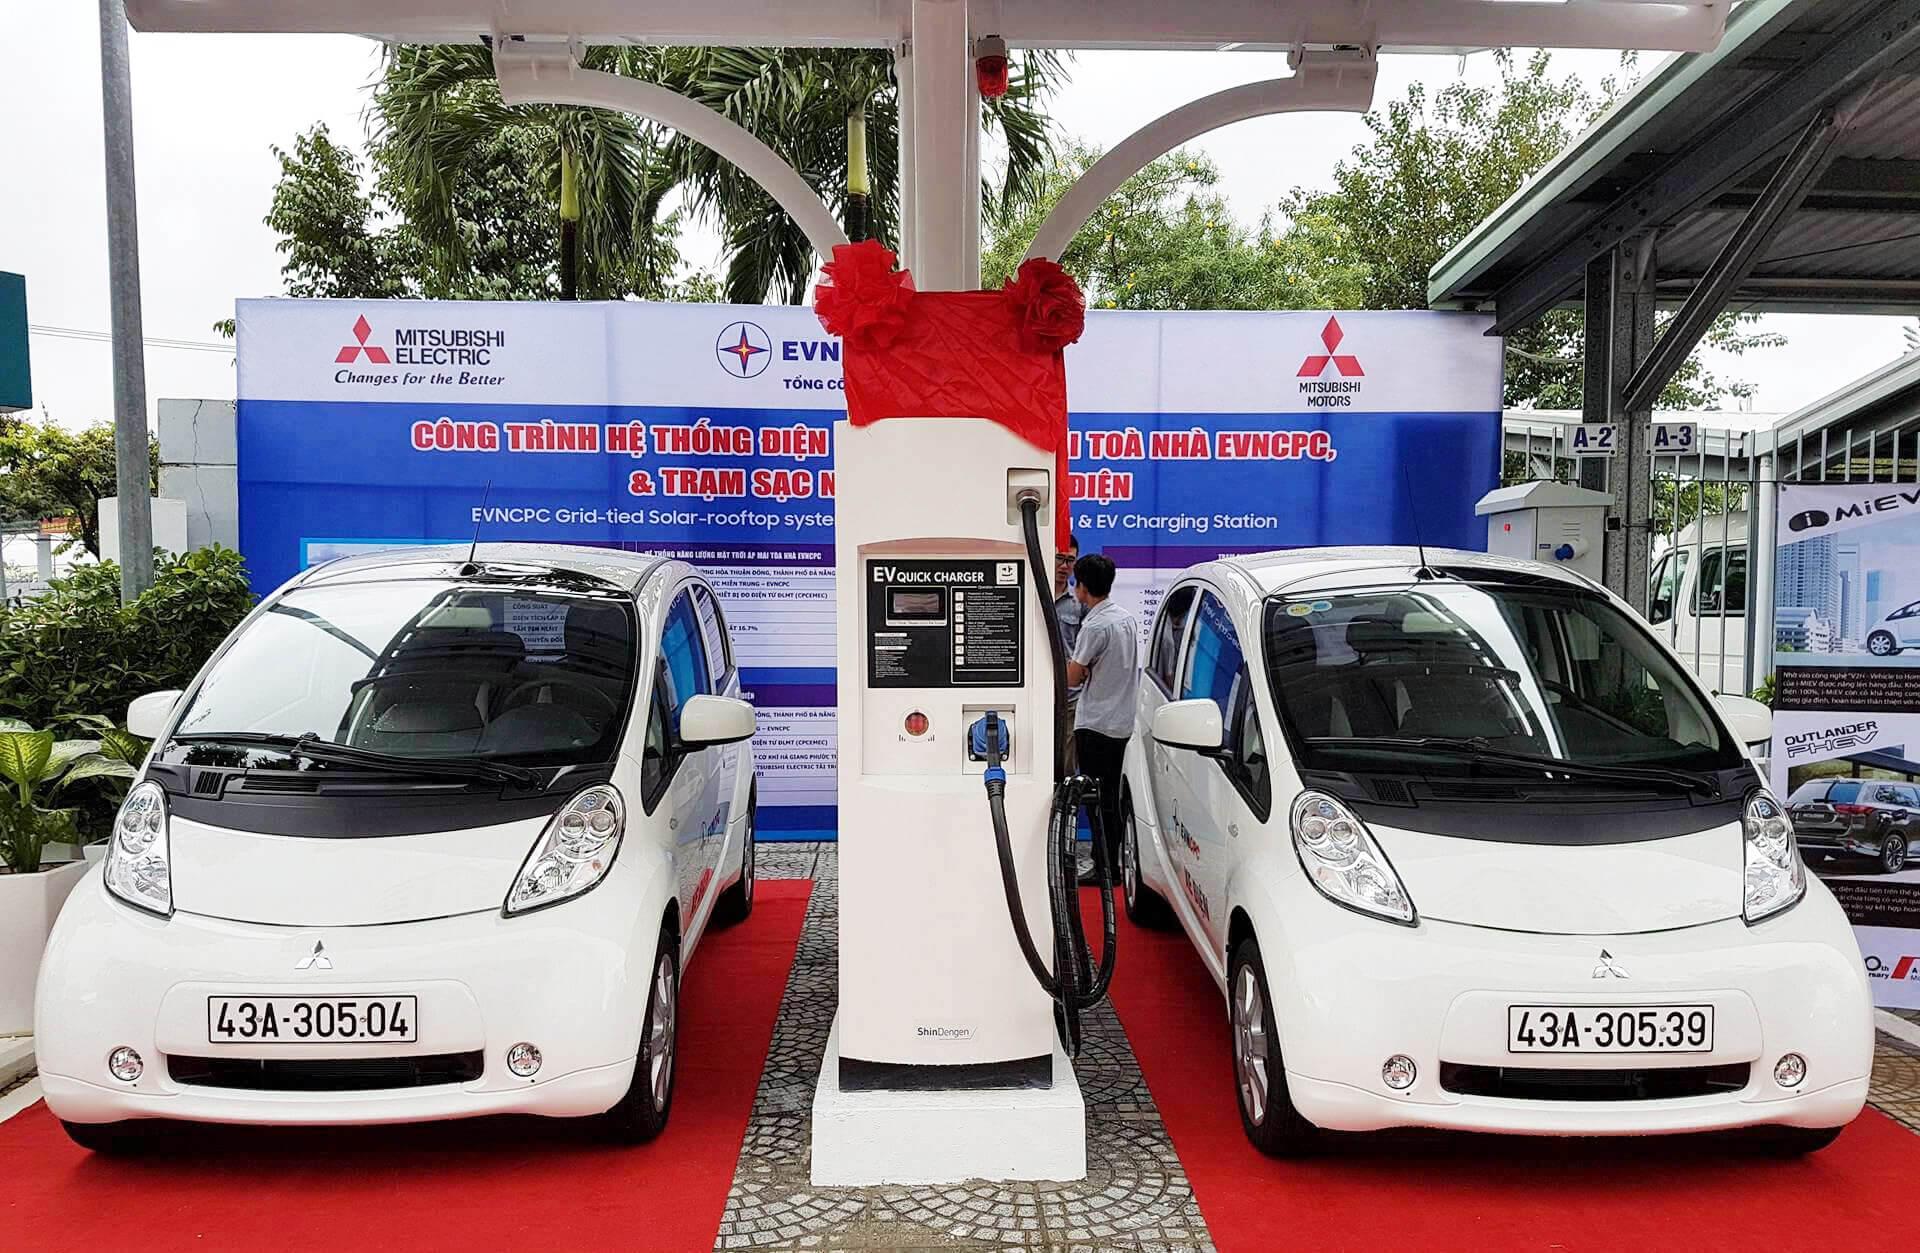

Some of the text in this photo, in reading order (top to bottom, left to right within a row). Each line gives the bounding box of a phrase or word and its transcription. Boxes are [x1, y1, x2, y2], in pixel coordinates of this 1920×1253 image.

[395, 329, 505, 347] MITSUBISHI
[395, 347, 491, 366] ELECTRIC
[334, 369, 506, 387] Changes for the Better
[782, 374, 846, 390] TỔNG CÔ
[1298, 381, 1361, 394] MITSUBISHI
[1306, 395, 1352, 408] MOTORS
[412, 418, 829, 461] CÔNG TRÌNH HỆ THỐNG ĐIỆN
[1087, 427, 1145, 459] TOÀ
[1151, 427, 1211, 459] NHÀ
[1216, 431, 1336, 462] EVNCPC,
[1572, 426, 1613, 449] A-2
[1653, 425, 1693, 447] A-3
[629, 470, 655, 496] &
[659, 467, 746, 502] TRẠM
[752, 468, 813, 502] SẠC
[1069, 468, 1133, 504] ĐIỆN
[471, 507, 836, 531] EVNCPC Grid-tied Solar-rooftop syste
[1077, 513, 1093, 530] &
[1096, 514, 1119, 529] EV
[1122, 513, 1209, 534] Charging
[1212, 513, 1278, 530] Station
[873, 565, 984, 584] EV QUICK CHARGER
[1784, 720, 1878, 746] OUTLANDER
[1787, 730, 1879, 759] PHEV
[216, 1001, 409, 1038] 43A-305.04
[1516, 1011, 1707, 1047] 43A-305.39
[917, 1026, 970, 1039] ShinDengen
